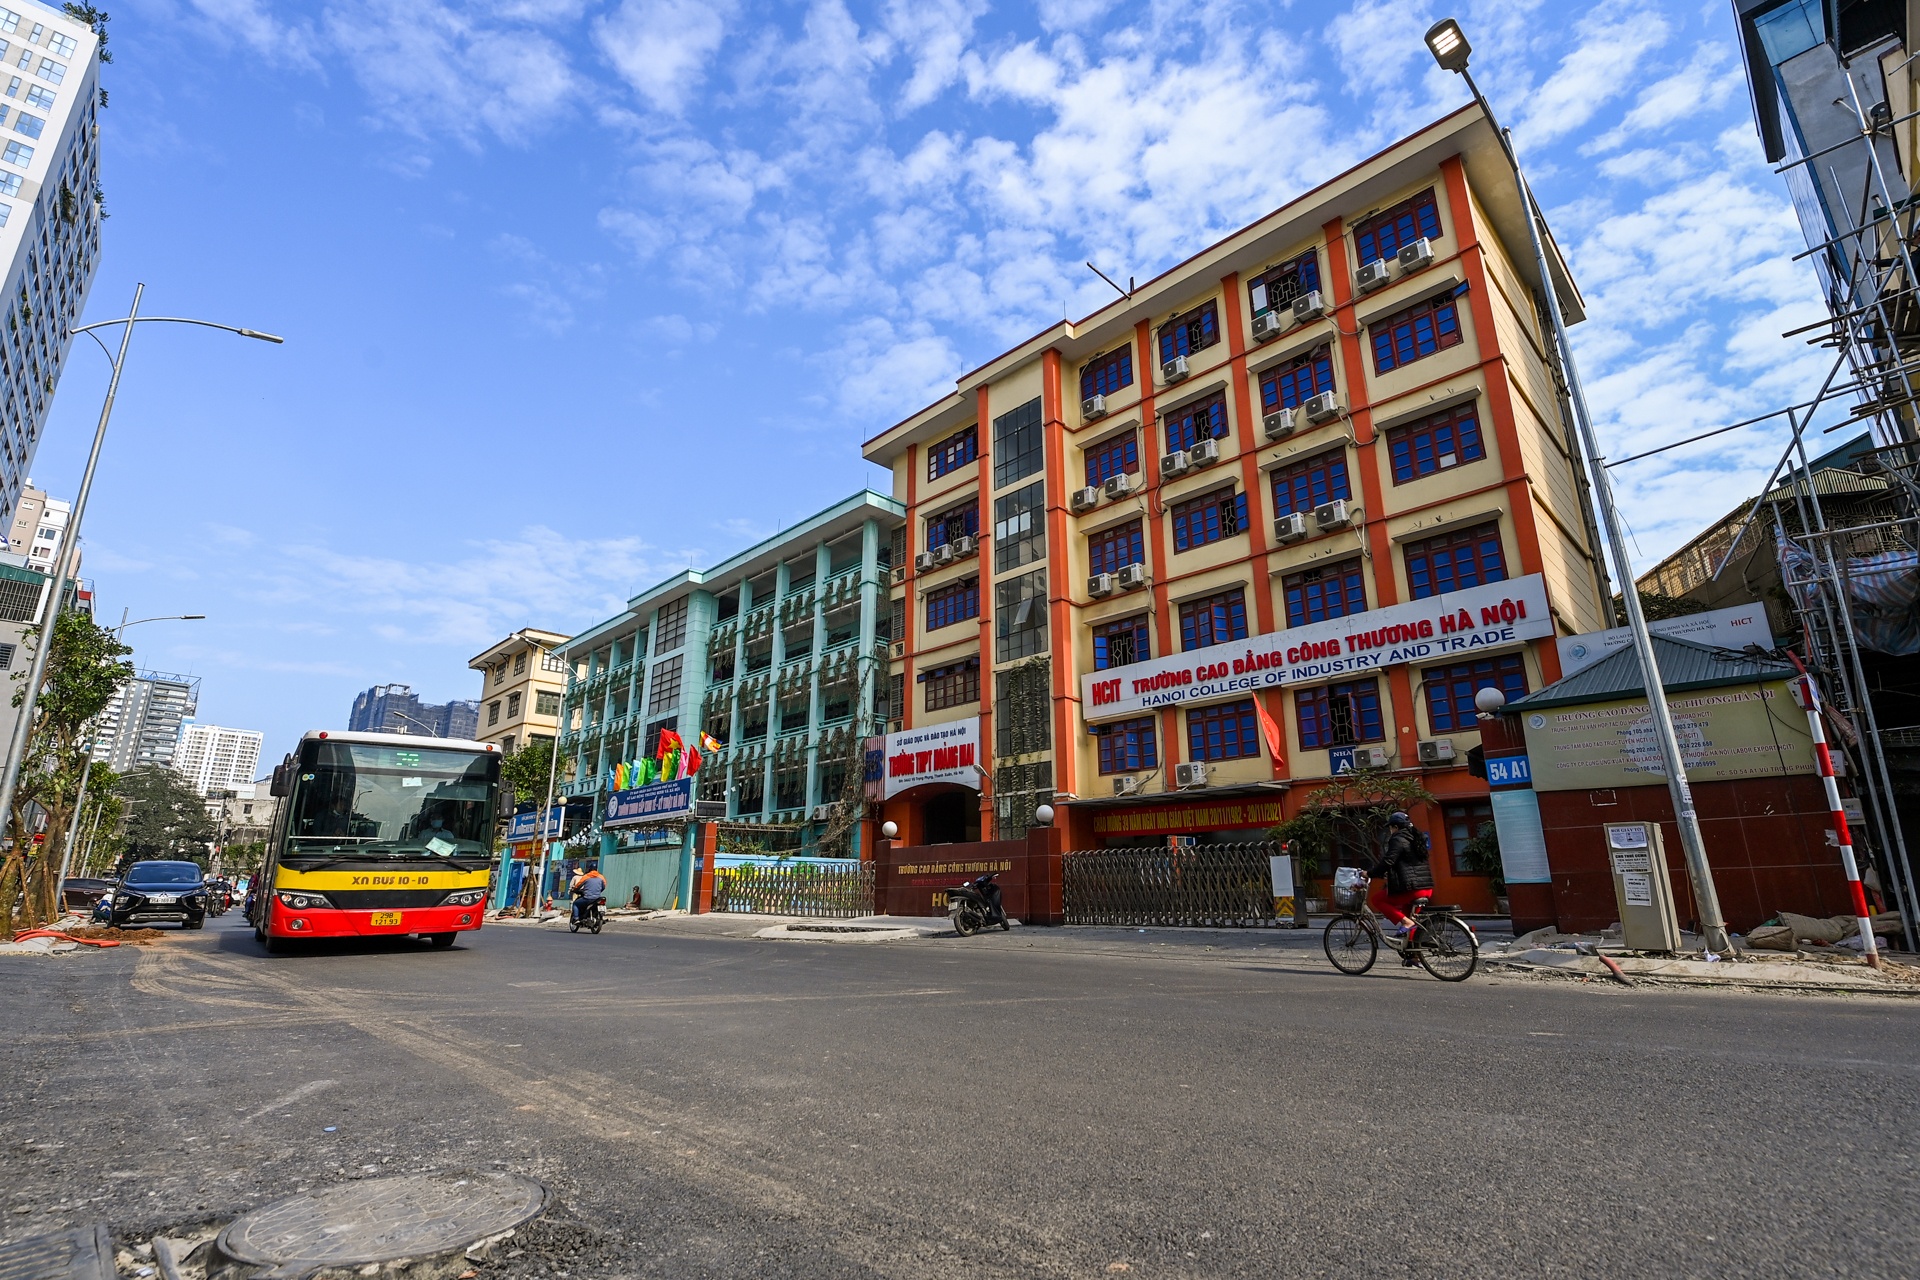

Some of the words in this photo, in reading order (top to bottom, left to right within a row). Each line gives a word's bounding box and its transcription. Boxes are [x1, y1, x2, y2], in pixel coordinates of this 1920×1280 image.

[1730, 617, 1753, 627] HICT
[1092, 678, 1121, 706] HCIT
[1132, 669, 1192, 694] TRƯỜNG
[1196, 661, 1229, 681] CAO
[1233, 649, 1283, 675] ĐẲNG
[1287, 638, 1341, 664] CÔNG
[1345, 619, 1433, 652] THƯƠNG
[1439, 608, 1475, 634] HÀ
[1481, 598, 1527, 626] NỘI
[1142, 690, 1186, 707] HANOI
[1189, 676, 1260, 697] COLLEGE
[1264, 671, 1288, 684] OF
[1292, 653, 1382, 679] INDUSTRY
[1389, 644, 1431, 662] AND
[1436, 627, 1516, 652] TRADE
[1684, 696, 1732, 709] THƯƠNG
[1733, 692, 1751, 704] HÀ
[1597, 707, 1619, 718] CAO
[949, 727, 957, 737] HÀ
[1333, 749, 1352, 758] NHÀ
[1336, 758, 1352, 773] A
[1490, 763, 1508, 781] 54
[1511, 760, 1529, 779] A1
[918, 865, 929, 874] CAO
[989, 859, 998, 872] HÀ
[372, 876, 396, 885] BUS
[398, 876, 410, 885] 10
[417, 876, 429, 885] 10
